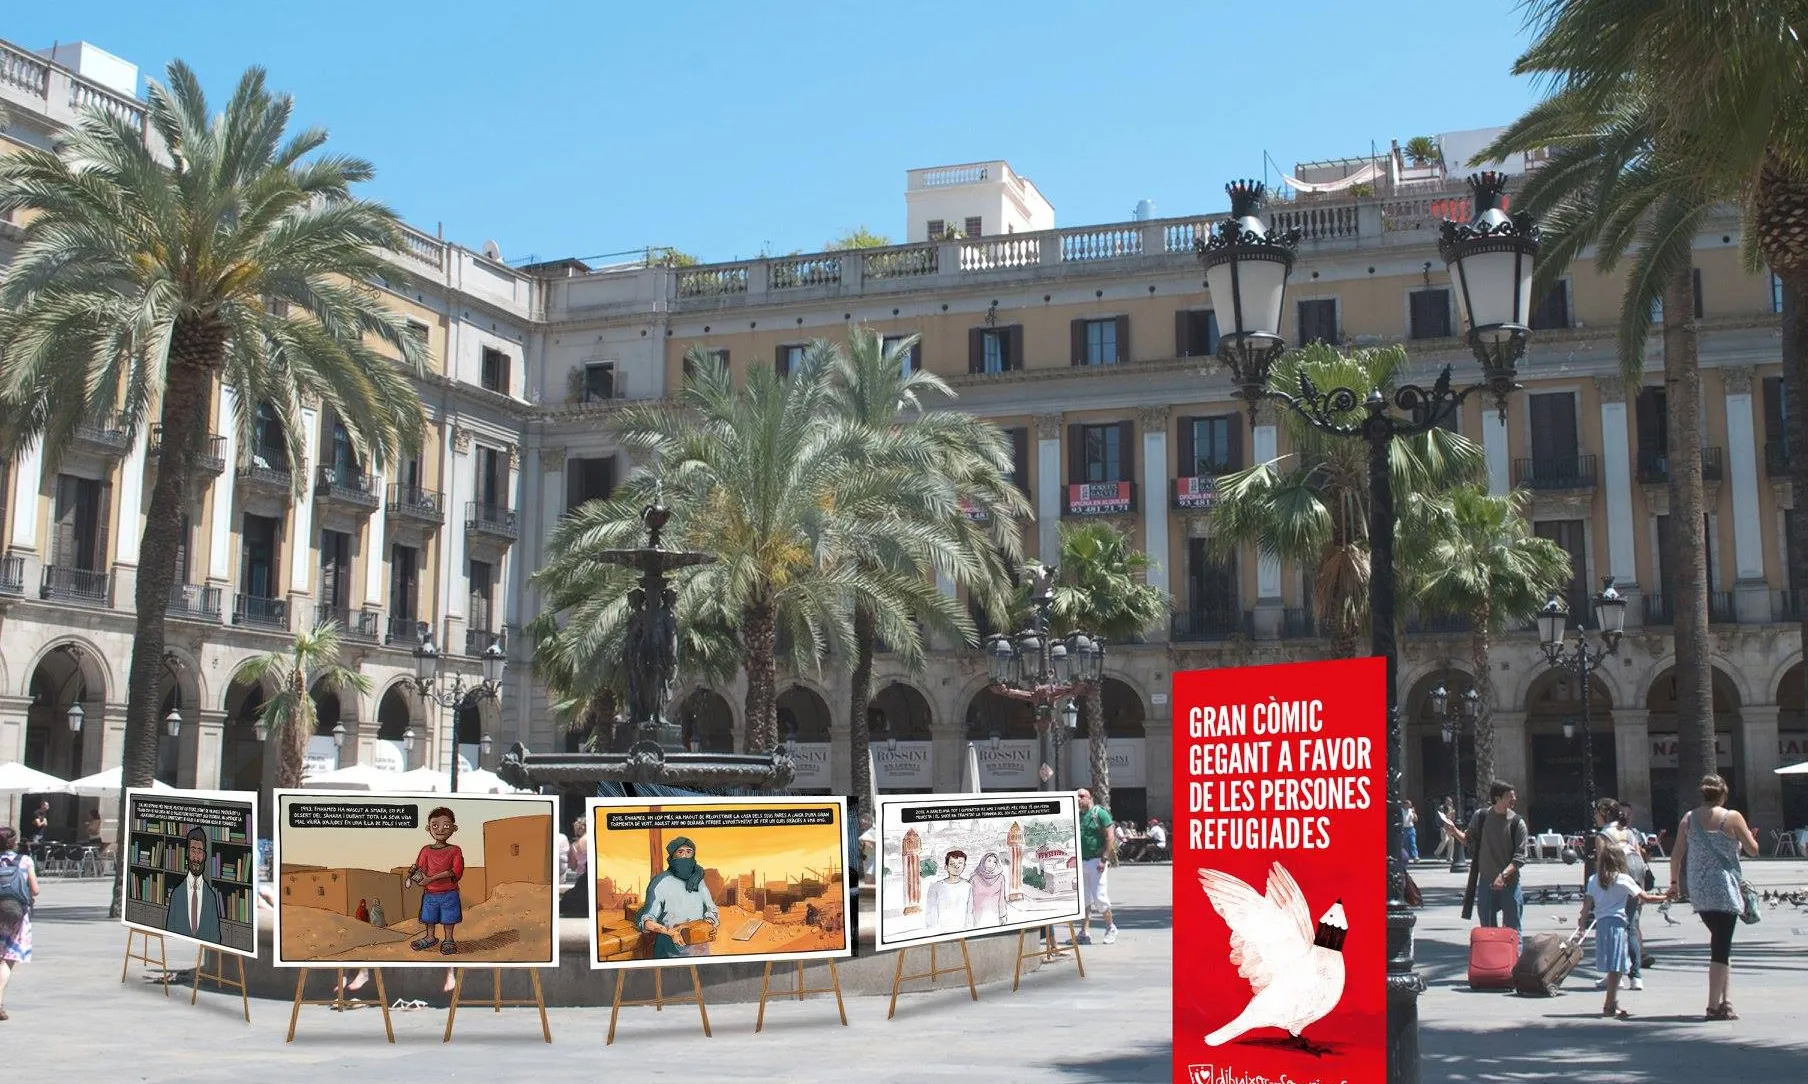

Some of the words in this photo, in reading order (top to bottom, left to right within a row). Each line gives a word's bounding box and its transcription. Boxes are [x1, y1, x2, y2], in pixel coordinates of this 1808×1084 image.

[1190, 704, 1246, 738] GRAN
[1253, 696, 1323, 735] CÒMIC
[878, 751, 927, 760] ROSSINI
[980, 750, 1031, 760] ROSSINI
[1190, 741, 1272, 775] GEGANT
[1278, 740, 1293, 772] A
[1300, 737, 1372, 772] FAVOR
[1190, 781, 1214, 812] DE
[1220, 780, 1255, 812] LES
[1261, 776, 1371, 811] PERSONES
[1190, 816, 1330, 850] REFUGIADES
